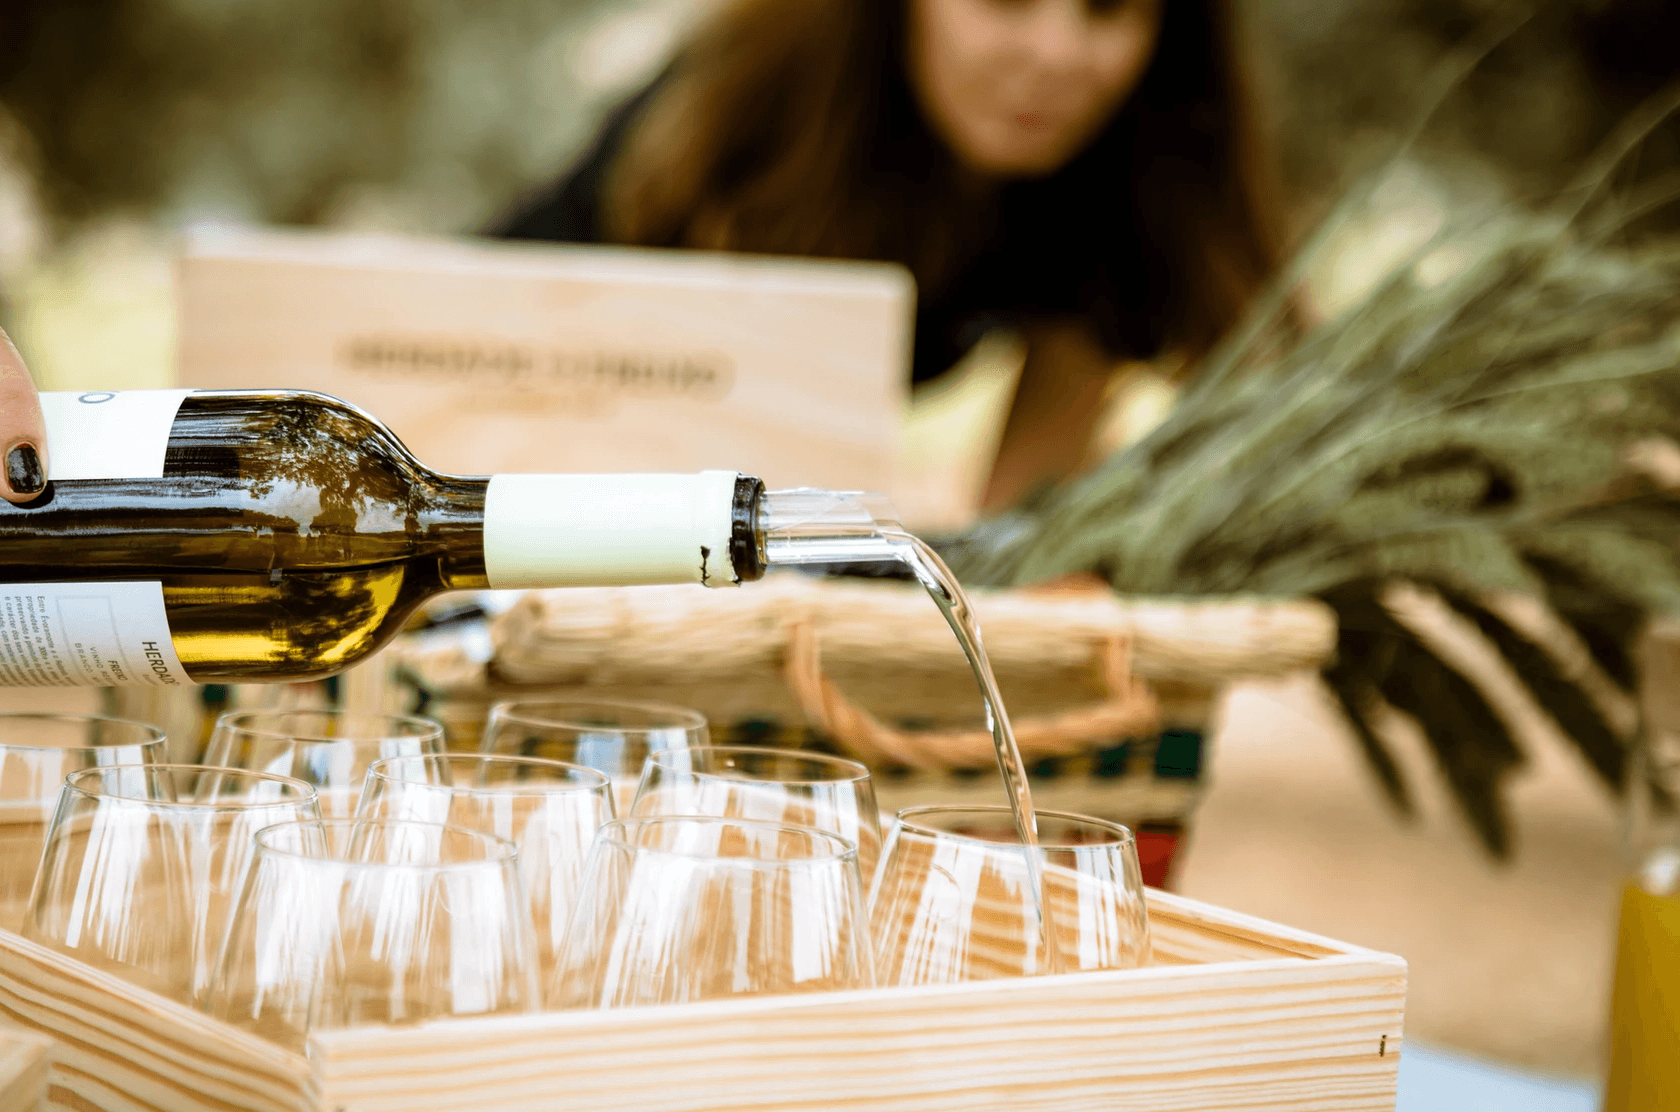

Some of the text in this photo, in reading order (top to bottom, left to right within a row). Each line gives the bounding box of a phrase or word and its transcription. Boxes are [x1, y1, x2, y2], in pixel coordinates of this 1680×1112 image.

[6, 602, 17, 629] carácter
[14, 596, 29, 635] preservando
[26, 596, 40, 633] propriedade
[37, 595, 46, 613] Entre
[75, 643, 93, 673] BRANCO
[90, 647, 104, 668] VINHO
